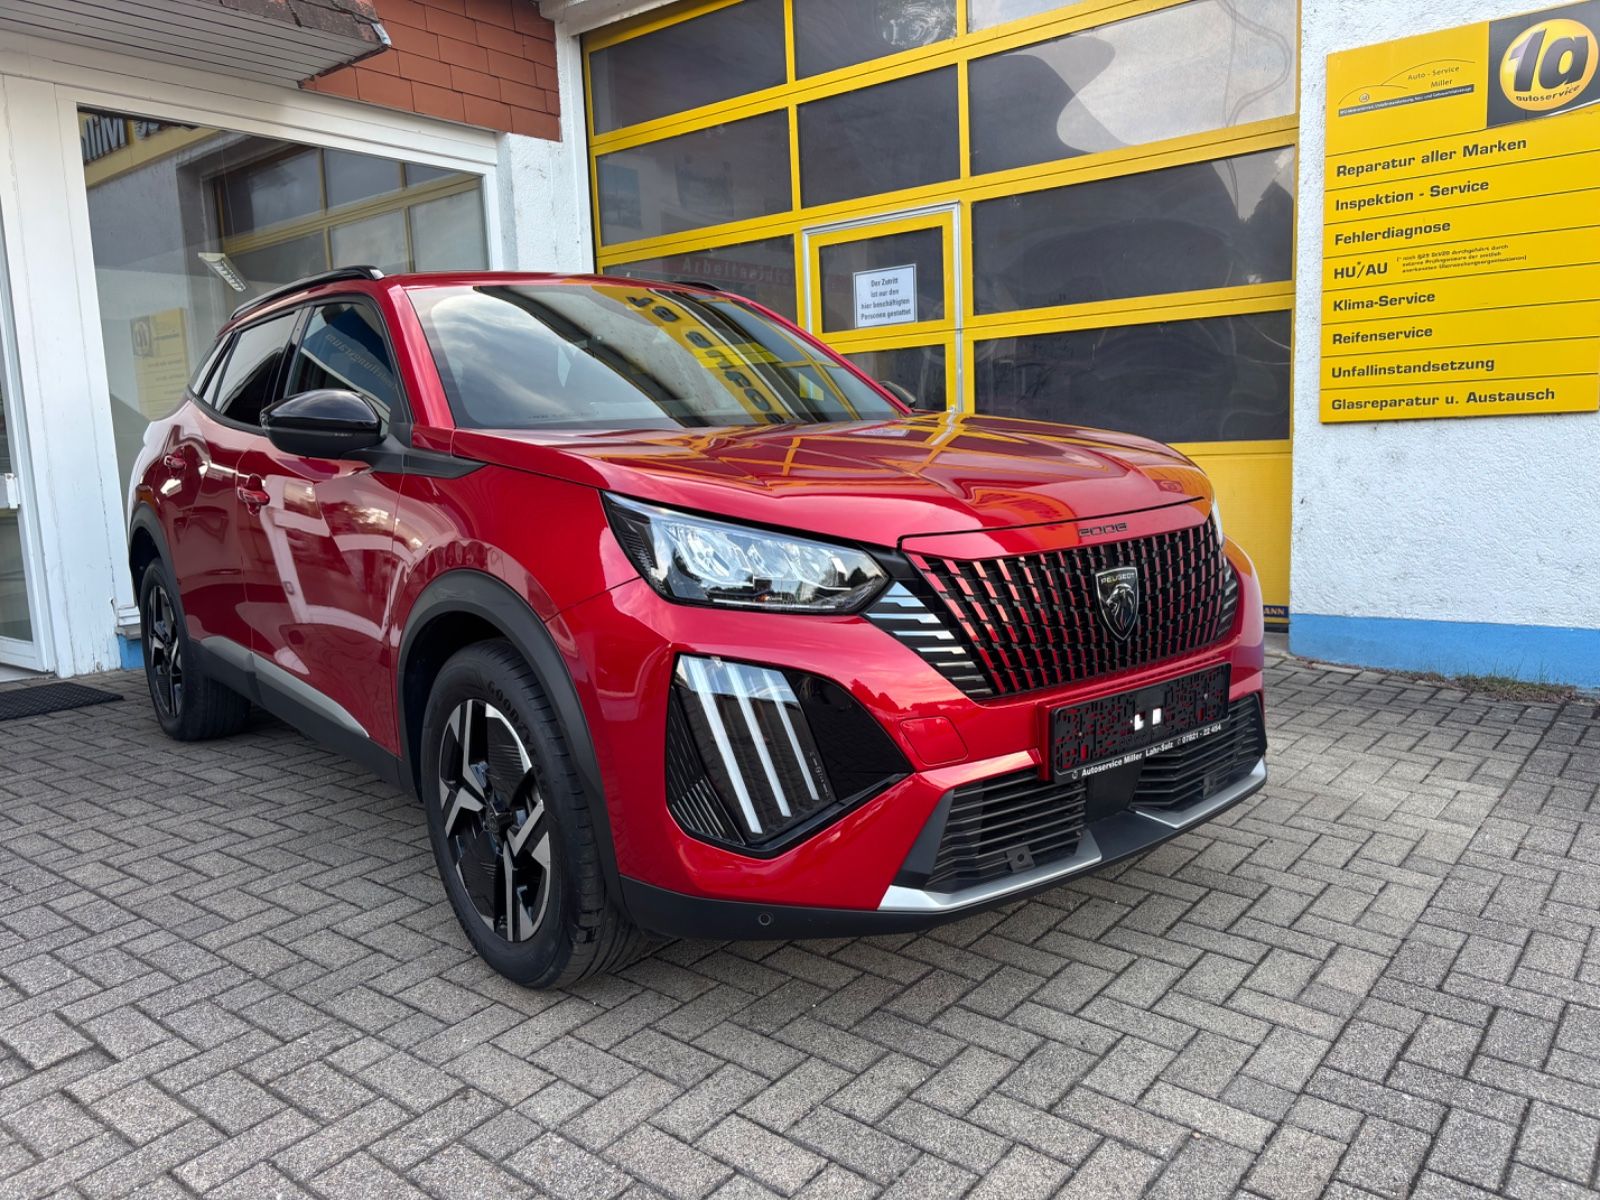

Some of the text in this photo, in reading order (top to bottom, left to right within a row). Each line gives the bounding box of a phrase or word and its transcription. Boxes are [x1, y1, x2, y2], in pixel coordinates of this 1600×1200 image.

[1509, 28, 1588, 92] 1a
[1408, 72, 1425, 81] Auto
[1432, 66, 1460, 77] Service
[1431, 79, 1453, 89] Miller
[1516, 84, 1580, 102] autoservice
[1336, 138, 1527, 178] Reparatur aller Marken
[1335, 190, 1414, 211] Inspektion
[1430, 180, 1489, 198] Service
[1334, 221, 1451, 246] Fehlerdiagnose
[871, 277, 898, 288] Der Zutritt
[889, 288, 899, 296] den
[861, 298, 910, 310] hier beschäftigten
[1333, 292, 1436, 312] Klima-Service
[861, 308, 911, 320] Personen gestattet
[1332, 327, 1433, 345] Reifenservice
[1331, 358, 1495, 379] Unfallinstandsetzung
[1331, 388, 1555, 411] Glasreparatur u. Austausch
[1079, 522, 1128, 537] 2008
[1100, 572, 1135, 584] PEUGEOT
[1082, 759, 1122, 776] Autoservice
[1124, 752, 1142, 764] Miller
[1146, 742, 1174, 757] Lahr-Sulz
